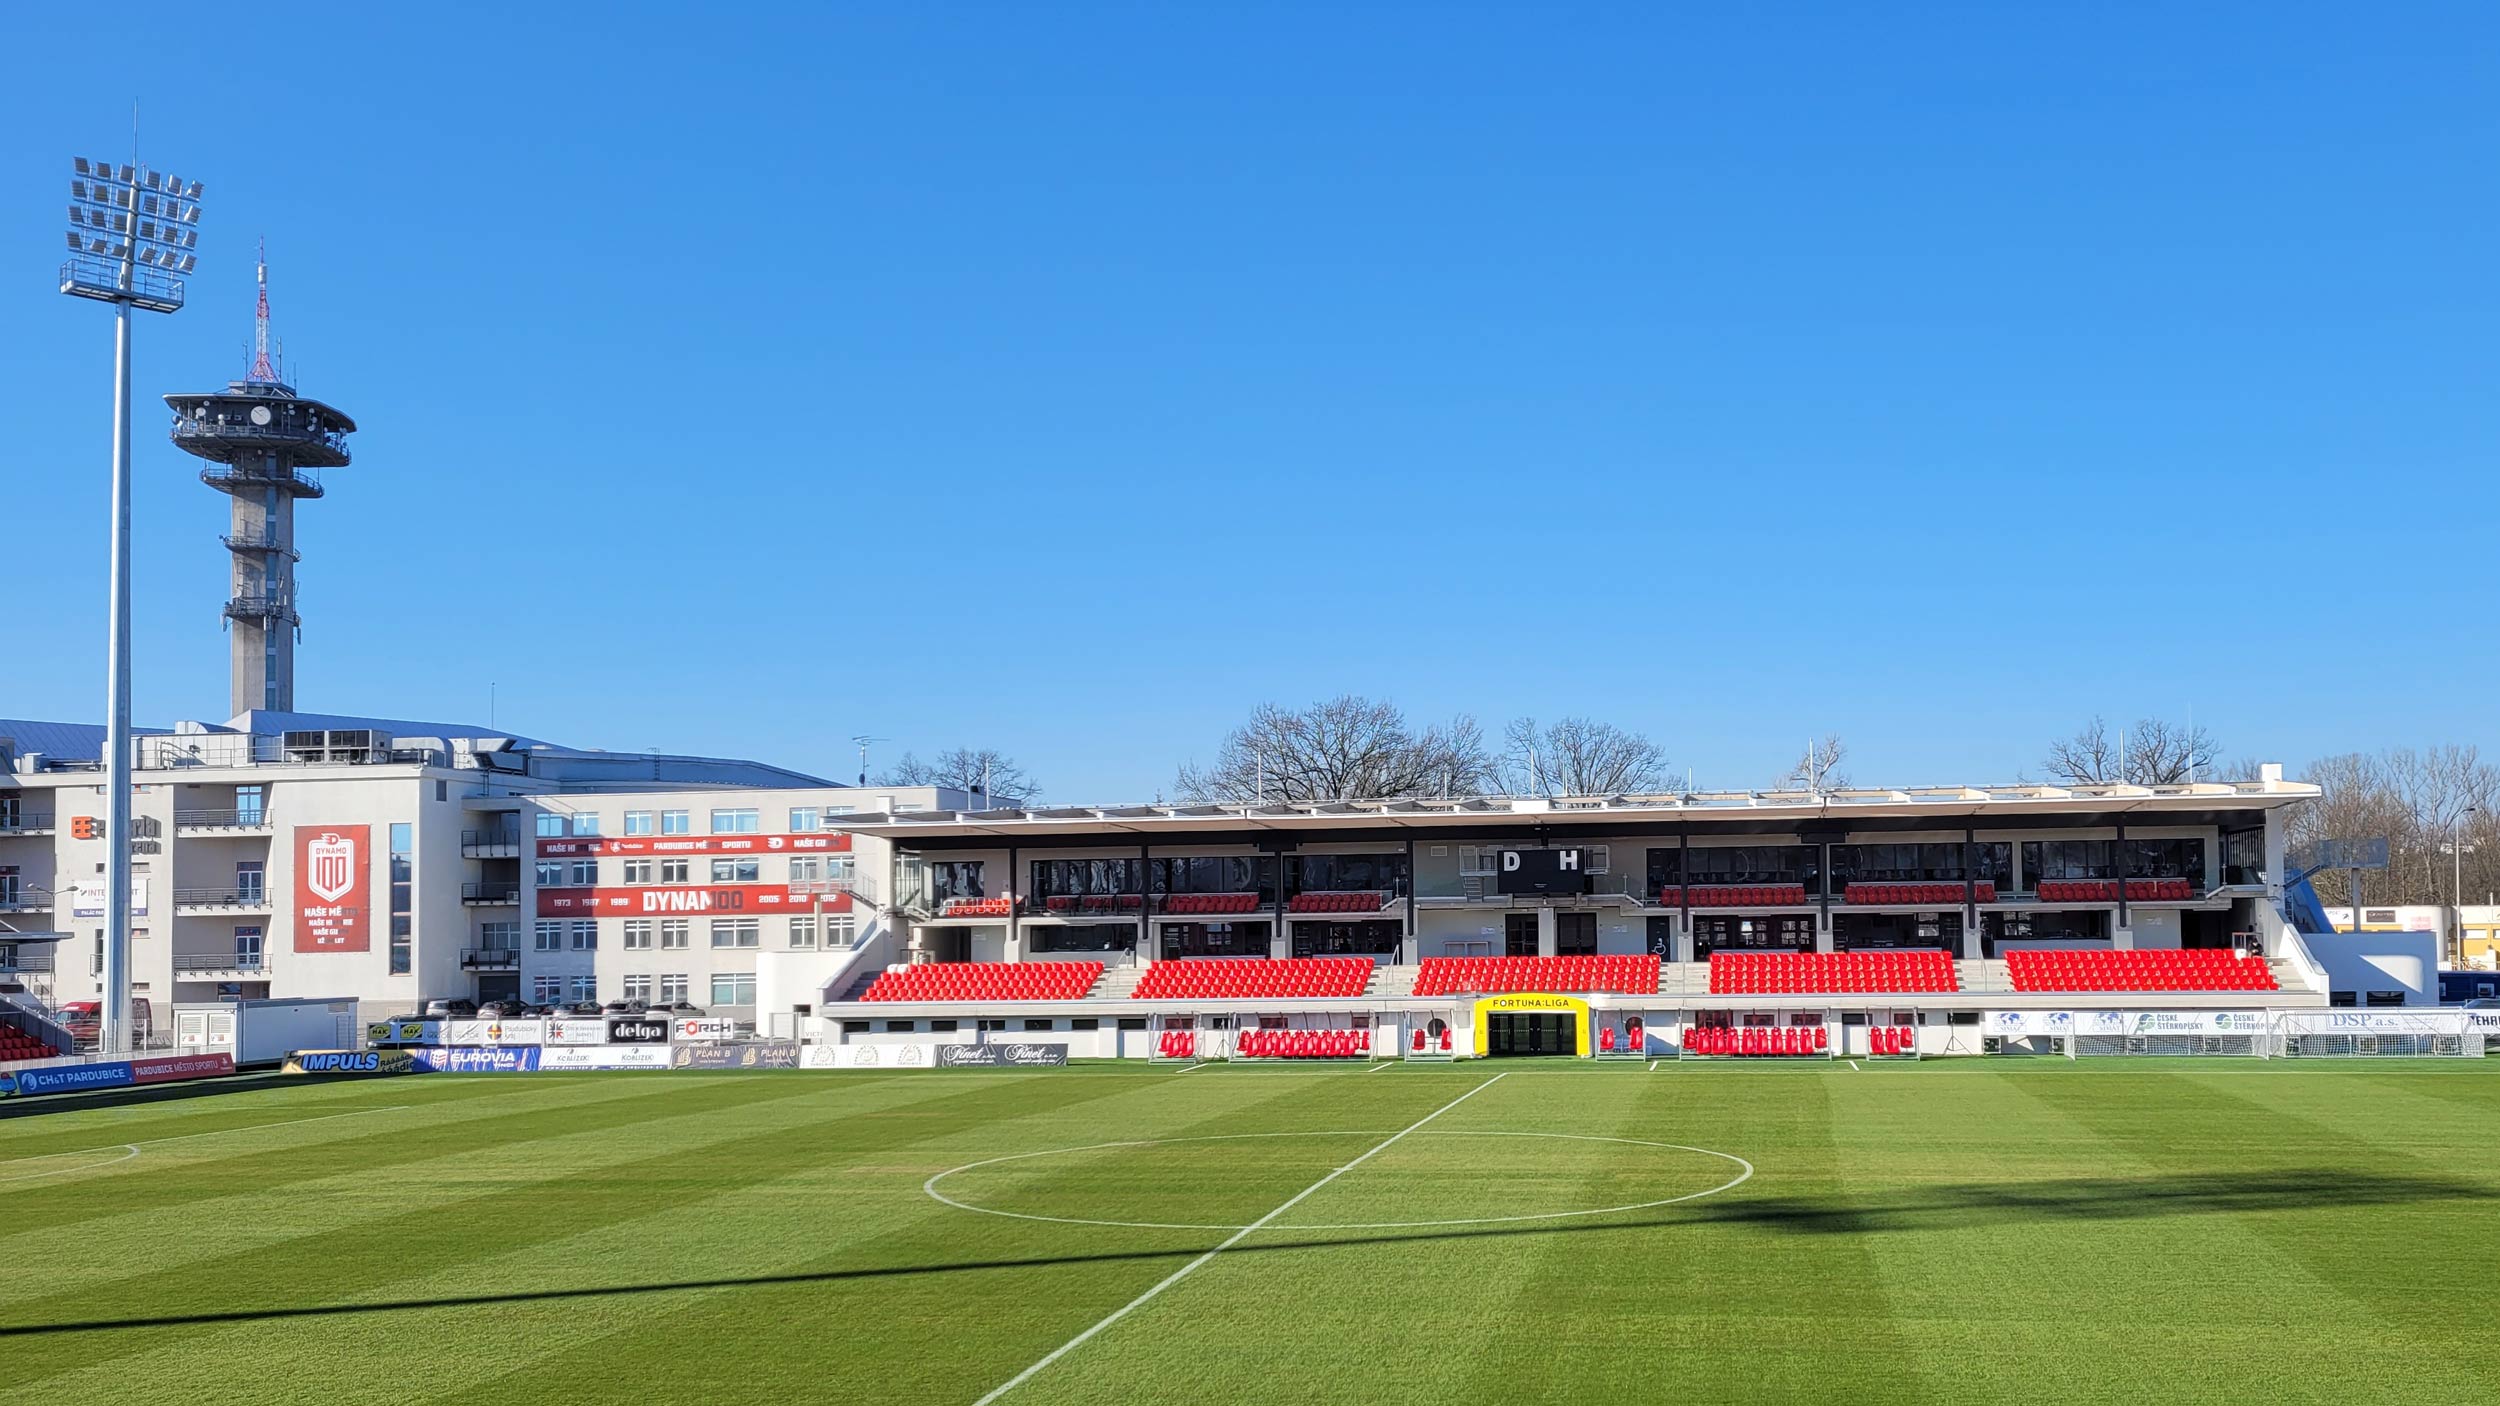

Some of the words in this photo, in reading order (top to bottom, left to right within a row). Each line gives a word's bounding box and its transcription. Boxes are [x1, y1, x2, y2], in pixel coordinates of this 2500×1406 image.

[653, 841, 694, 850] PARDUBICE
[722, 840, 751, 849] SPORTU
[316, 847, 347, 855] DYNAMO
[1503, 852, 1521, 871] D
[1559, 851, 1578, 870] H
[554, 898, 571, 907] 1973
[758, 895, 780, 903] 2005
[788, 894, 808, 903] 2010
[304, 905, 327, 917] NAŠE
[2157, 1013, 2178, 1021] ČESKÉ
[2233, 1013, 2255, 1021] ČESKÉ
[2332, 1013, 2371, 1027] DSP
[615, 1023, 661, 1040] delga
[450, 1052, 516, 1062] EUROVIA
[696, 1049, 720, 1058] PLAN
[725, 1049, 731, 1058] B
[760, 1049, 786, 1057] PLAN
[301, 1052, 379, 1071] IMPULS
[135, 1064, 174, 1076] PARDUBICE
[174, 1061, 195, 1072] MĚSTO
[195, 1060, 218, 1071] SPORTU
[66, 1068, 126, 1083] PARDUBICE
